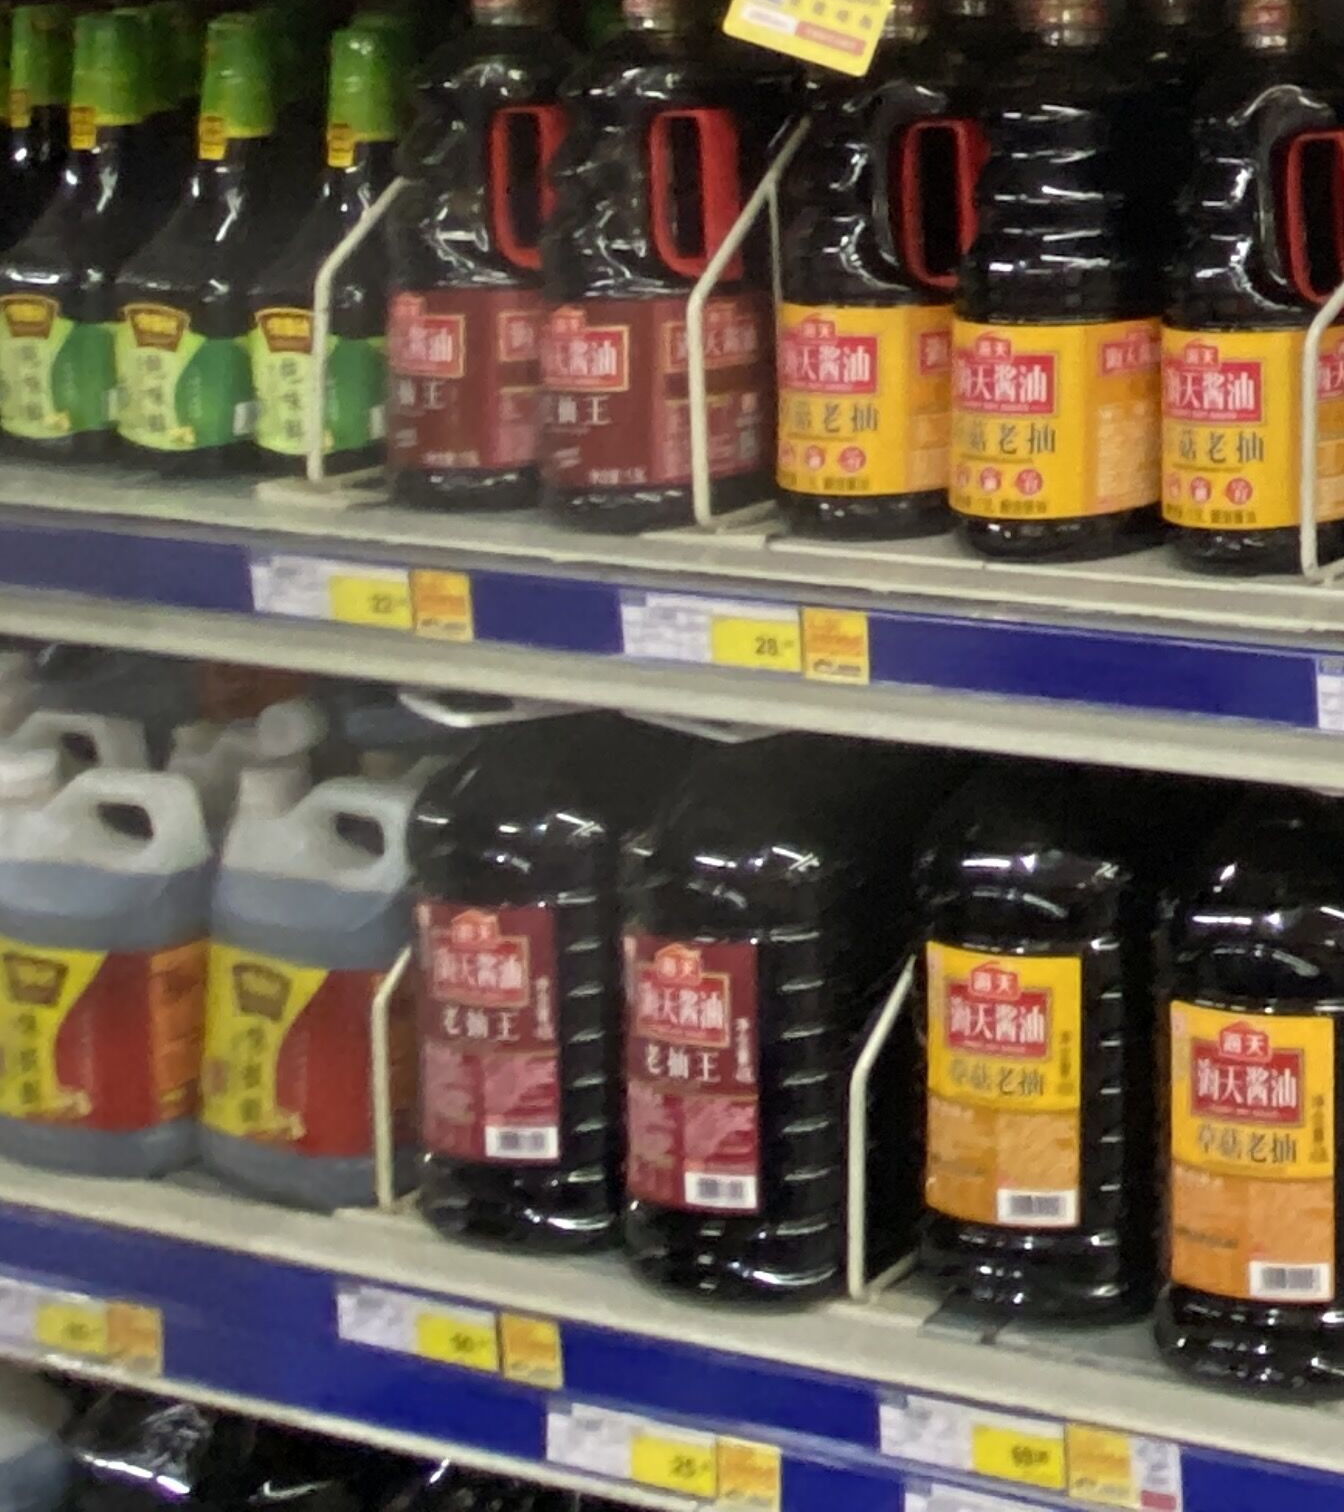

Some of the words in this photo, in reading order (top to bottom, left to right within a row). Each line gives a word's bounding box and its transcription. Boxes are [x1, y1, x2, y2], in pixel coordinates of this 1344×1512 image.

[950, 997, 1046, 1045] 海天酱油
[1196, 1058, 1298, 1108] 海天酱油
